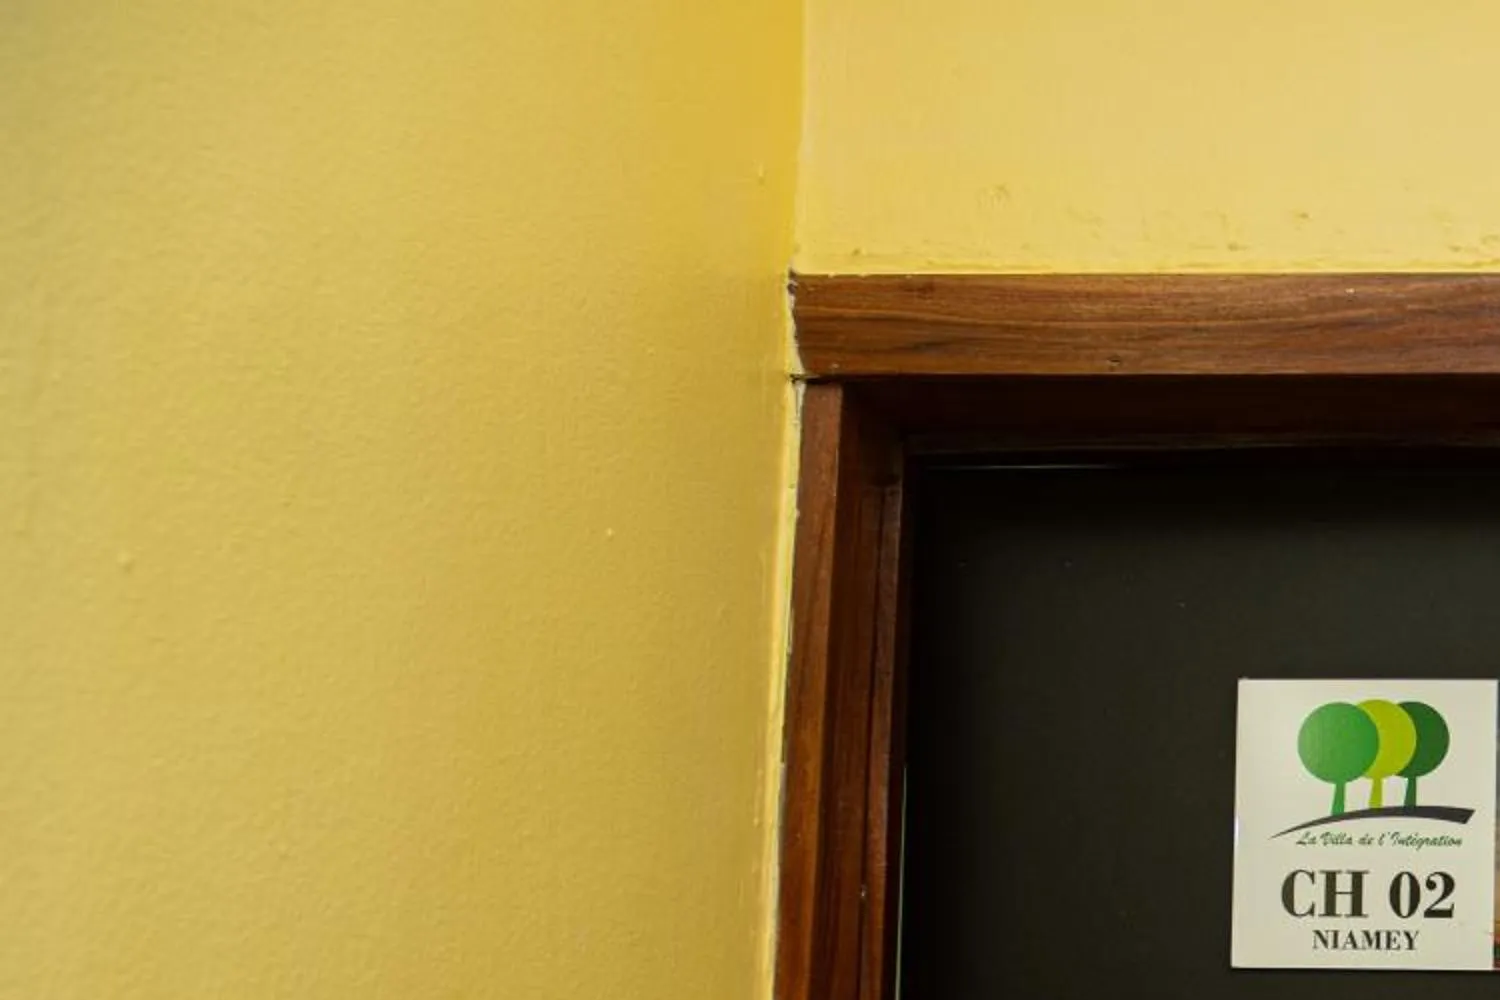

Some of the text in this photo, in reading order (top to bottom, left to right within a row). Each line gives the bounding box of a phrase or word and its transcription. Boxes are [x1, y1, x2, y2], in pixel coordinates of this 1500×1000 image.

[1296, 831, 1317, 846] La
[1320, 831, 1353, 846] Villa
[1358, 833, 1374, 846] de
[1281, 869, 1456, 919] CH 02
[1312, 929, 1420, 951] NIAMEY
